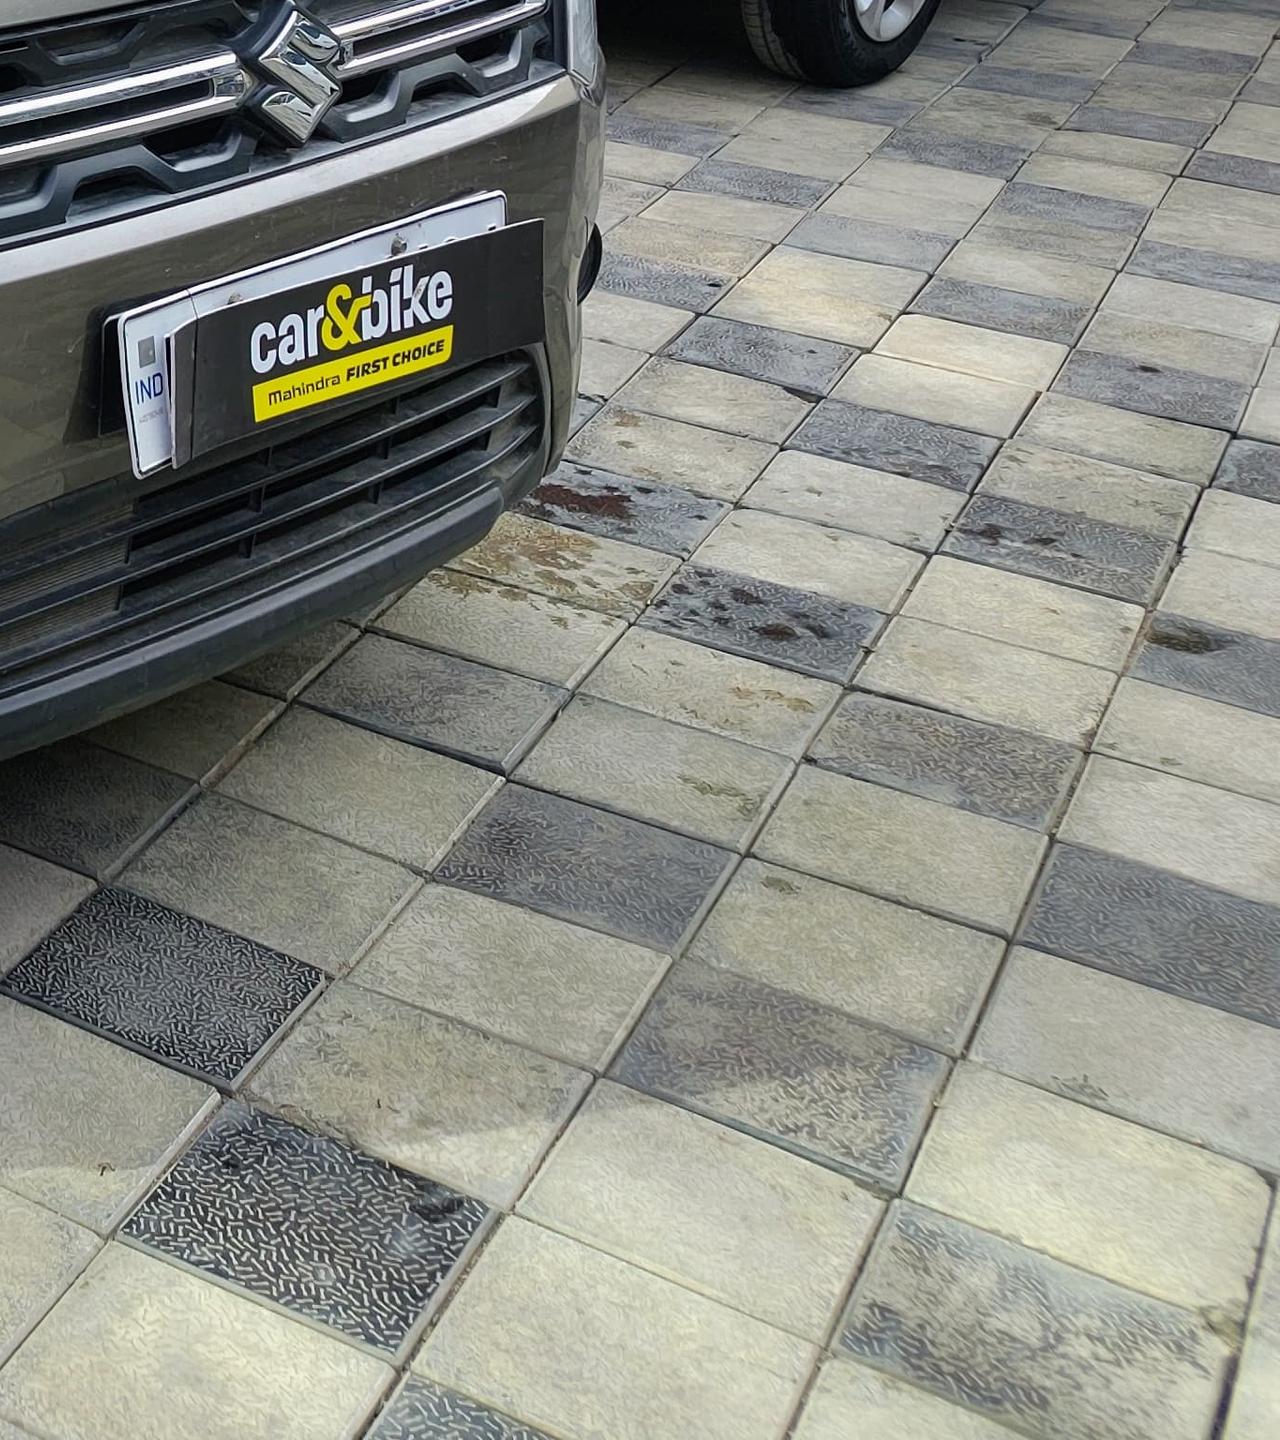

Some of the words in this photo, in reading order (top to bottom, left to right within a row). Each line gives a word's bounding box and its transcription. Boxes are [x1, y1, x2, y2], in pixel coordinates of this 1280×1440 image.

[249, 264, 454, 374] car&bike
[134, 372, 164, 406] IND
[267, 371, 341, 407] Mahindra
[345, 354, 390, 383] FIRST
[391, 338, 446, 368] CHOICE
